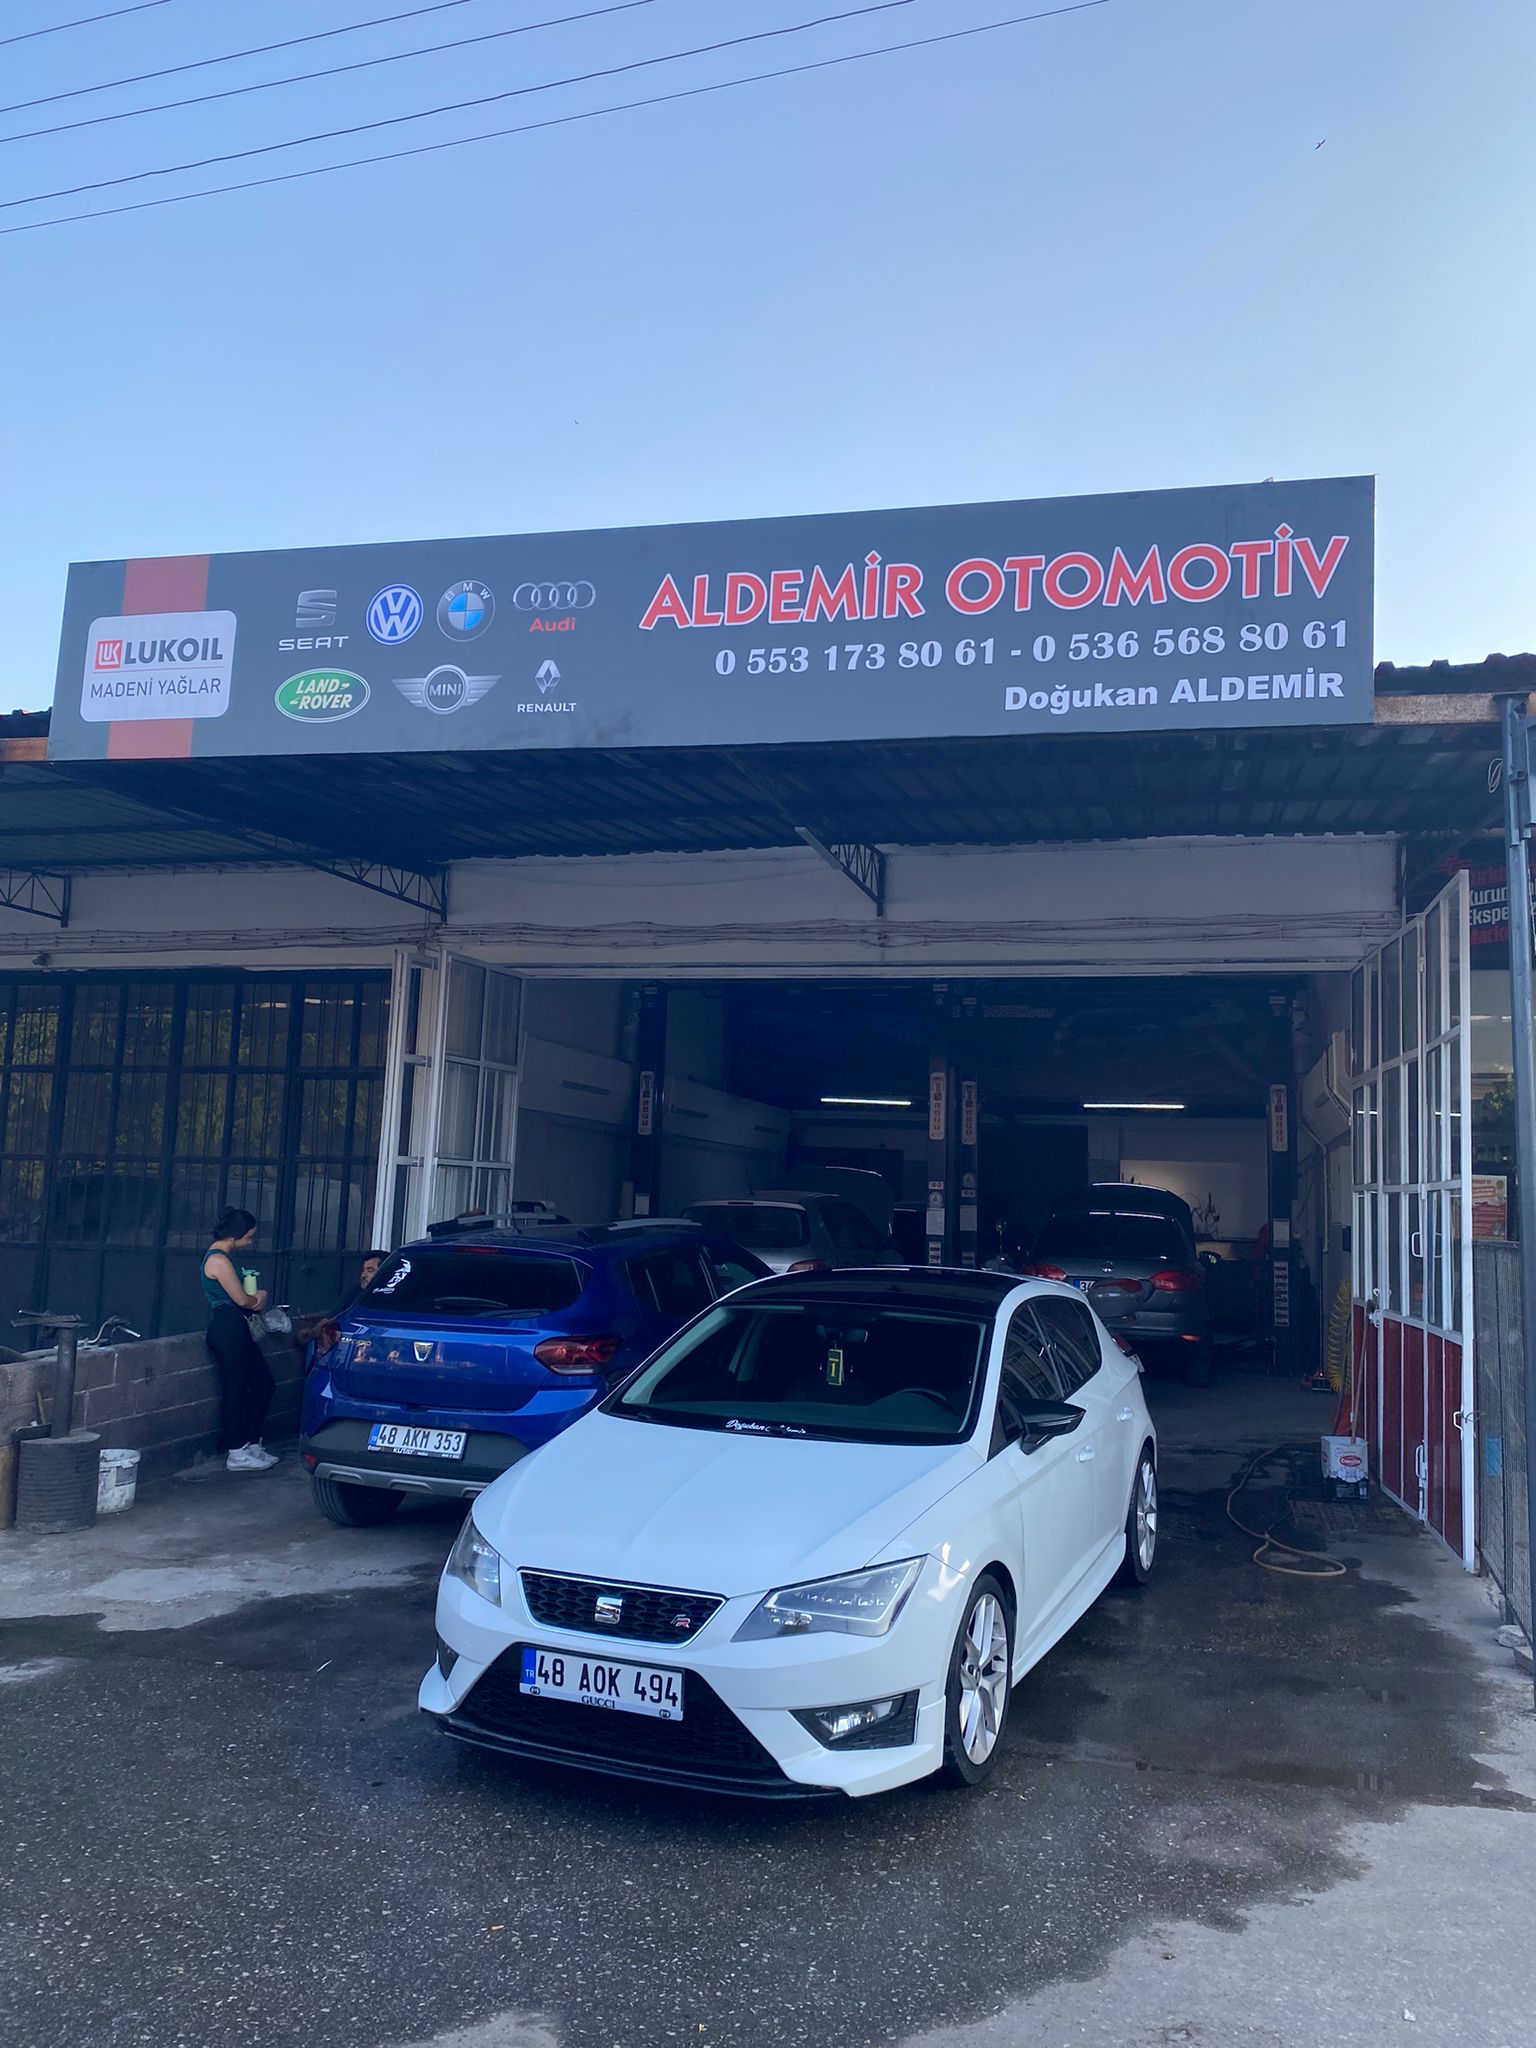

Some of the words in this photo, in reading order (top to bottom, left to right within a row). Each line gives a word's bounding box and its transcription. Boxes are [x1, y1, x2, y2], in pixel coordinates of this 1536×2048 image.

[639, 550, 926, 630] ALDEMİR
[945, 522, 1349, 615] OTOMOTİV
[529, 617, 576, 632] Audi
[124, 637, 223, 665] LUKOIL
[279, 635, 349, 651] SEAT
[715, 650, 736, 675] 0
[747, 647, 809, 674] 553
[824, 643, 886, 671] 173
[898, 640, 943, 668] 80
[955, 638, 994, 666] 61
[1032, 635, 1056, 662] 0
[1068, 630, 1139, 660] 536
[1153, 626, 1225, 656] 568
[1239, 622, 1289, 651] 80
[1303, 620, 1346, 649] 61
[91, 678, 153, 699] MADENİ
[158, 675, 221, 695] YAĞLAR
[296, 679, 340, 694] LAND
[429, 683, 462, 696] MINI
[1004, 682, 1158, 715] Doğukan
[1169, 667, 1344, 704] ALDEMİR
[298, 694, 352, 710] ROVER
[517, 702, 577, 713] RENAULT
[379, 1425, 398, 1445] 48
[402, 1428, 430, 1449] AKM
[434, 1432, 462, 1452] 353
[525, 1669, 535, 1678] TR
[537, 1655, 565, 1688] 48
[578, 1663, 622, 1697] AOK
[634, 1671, 679, 1707] 494
[581, 1695, 616, 1709] GUCCI
